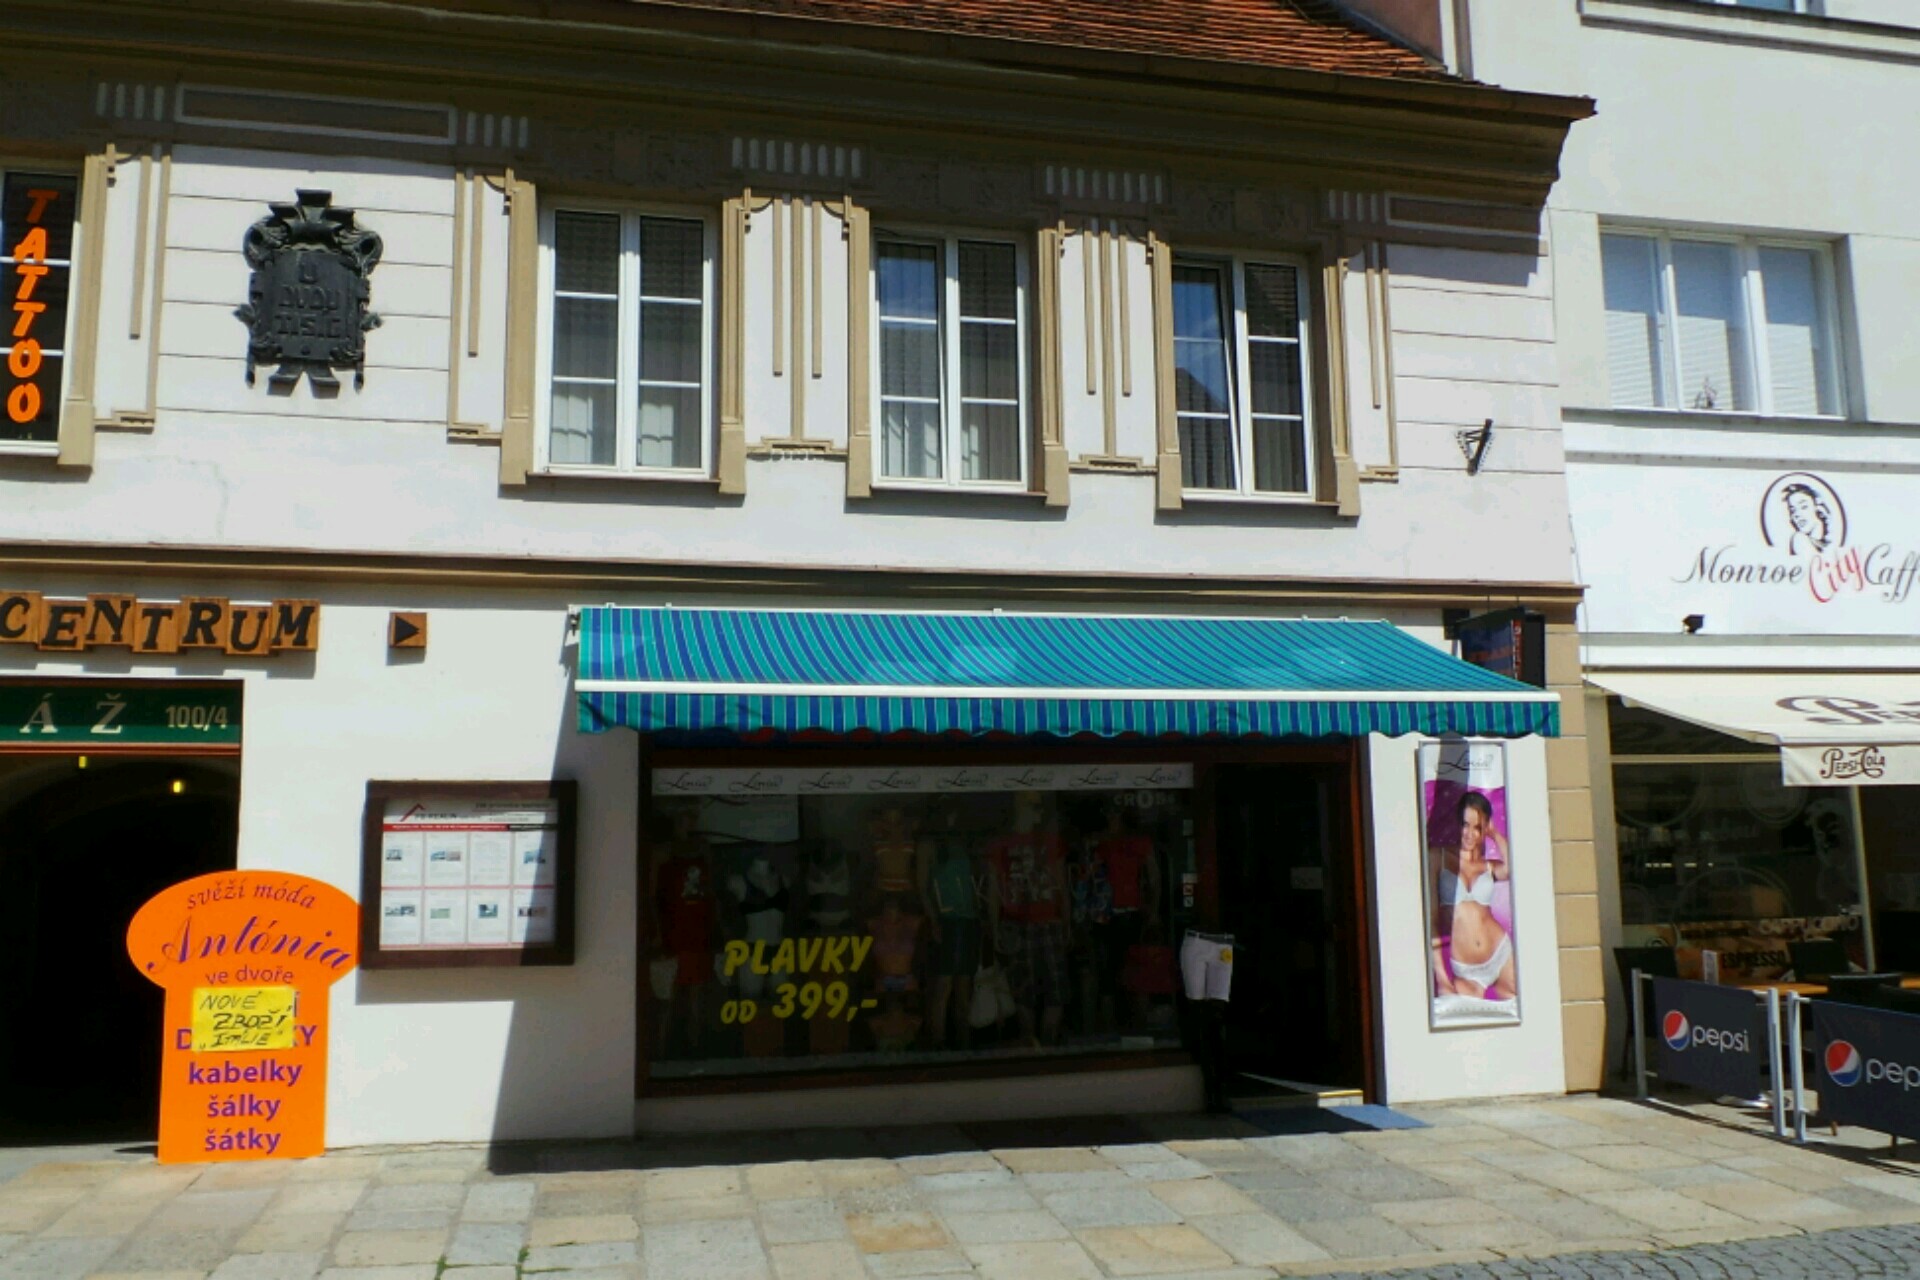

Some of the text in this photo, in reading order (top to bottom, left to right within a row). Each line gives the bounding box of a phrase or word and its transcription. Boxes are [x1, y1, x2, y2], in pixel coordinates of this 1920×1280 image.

[7, 189, 58, 423] TATTOO
[1670, 542, 1920, 604] Monroe City Caff
[0, 596, 316, 653] CENTRUM
[165, 704, 229, 731] 100/4
[187, 877, 317, 910] svěží móda
[146, 915, 353, 973] Antónia
[723, 936, 874, 976] PLAVKY
[205, 965, 294, 985] ve dvoře
[200, 990, 262, 1010] NOVÉ
[720, 981, 878, 1024] OD 399,-
[1692, 1024, 1749, 1053] pepsi
[188, 1059, 303, 1087] kabelky
[207, 1094, 281, 1121] šálky
[205, 1127, 281, 1155] šátky
